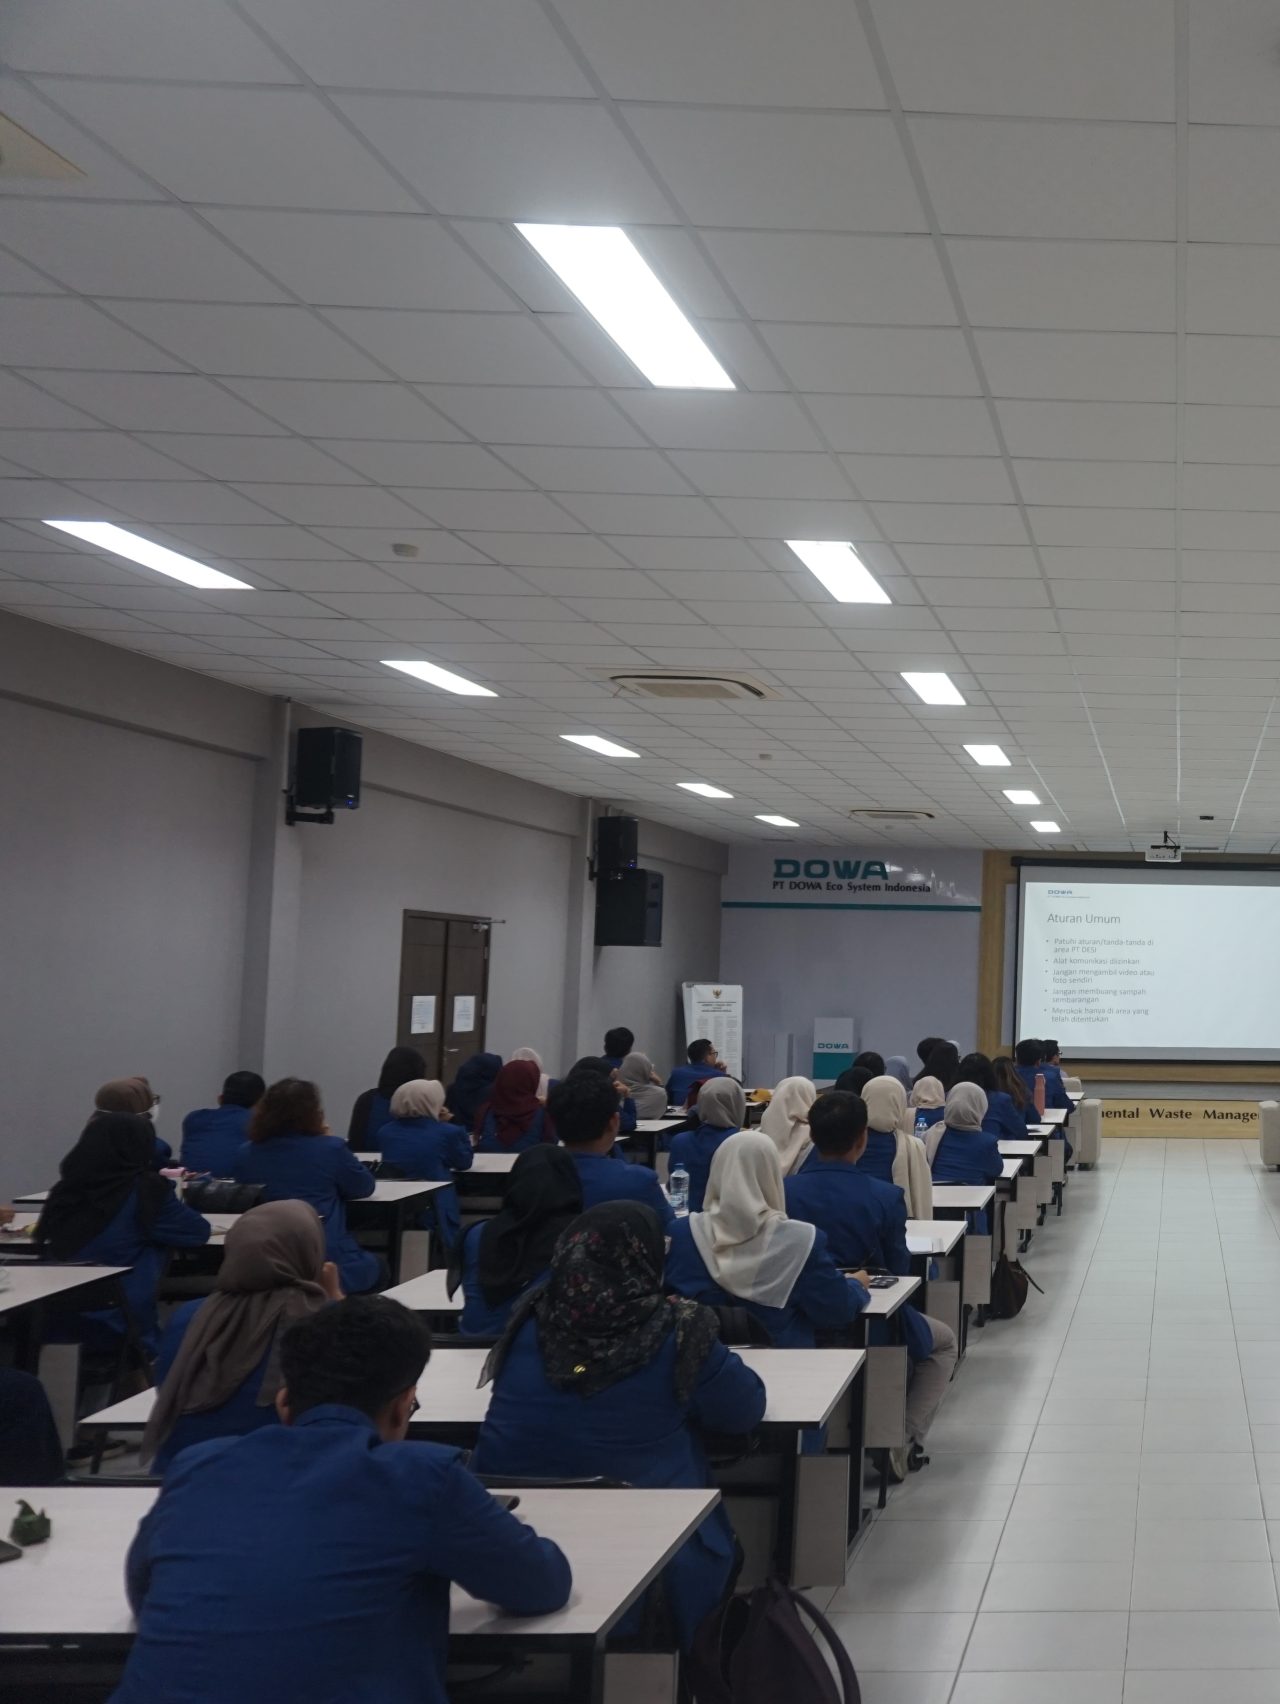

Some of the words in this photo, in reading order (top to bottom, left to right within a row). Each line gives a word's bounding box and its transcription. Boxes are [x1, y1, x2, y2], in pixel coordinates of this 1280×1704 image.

[773, 858, 889, 881] DOWA
[772, 880, 784, 890] PT
[789, 881, 822, 891] DOWA
[826, 881, 843, 891] Eco
[847, 882, 881, 894] System
[885, 883, 931, 893] Indonesia
[1047, 913, 1082, 924] Aturan
[1085, 914, 1121, 924] Umum
[1149, 1107, 1193, 1119] Waste
[1202, 1108, 1260, 1123] Manage
